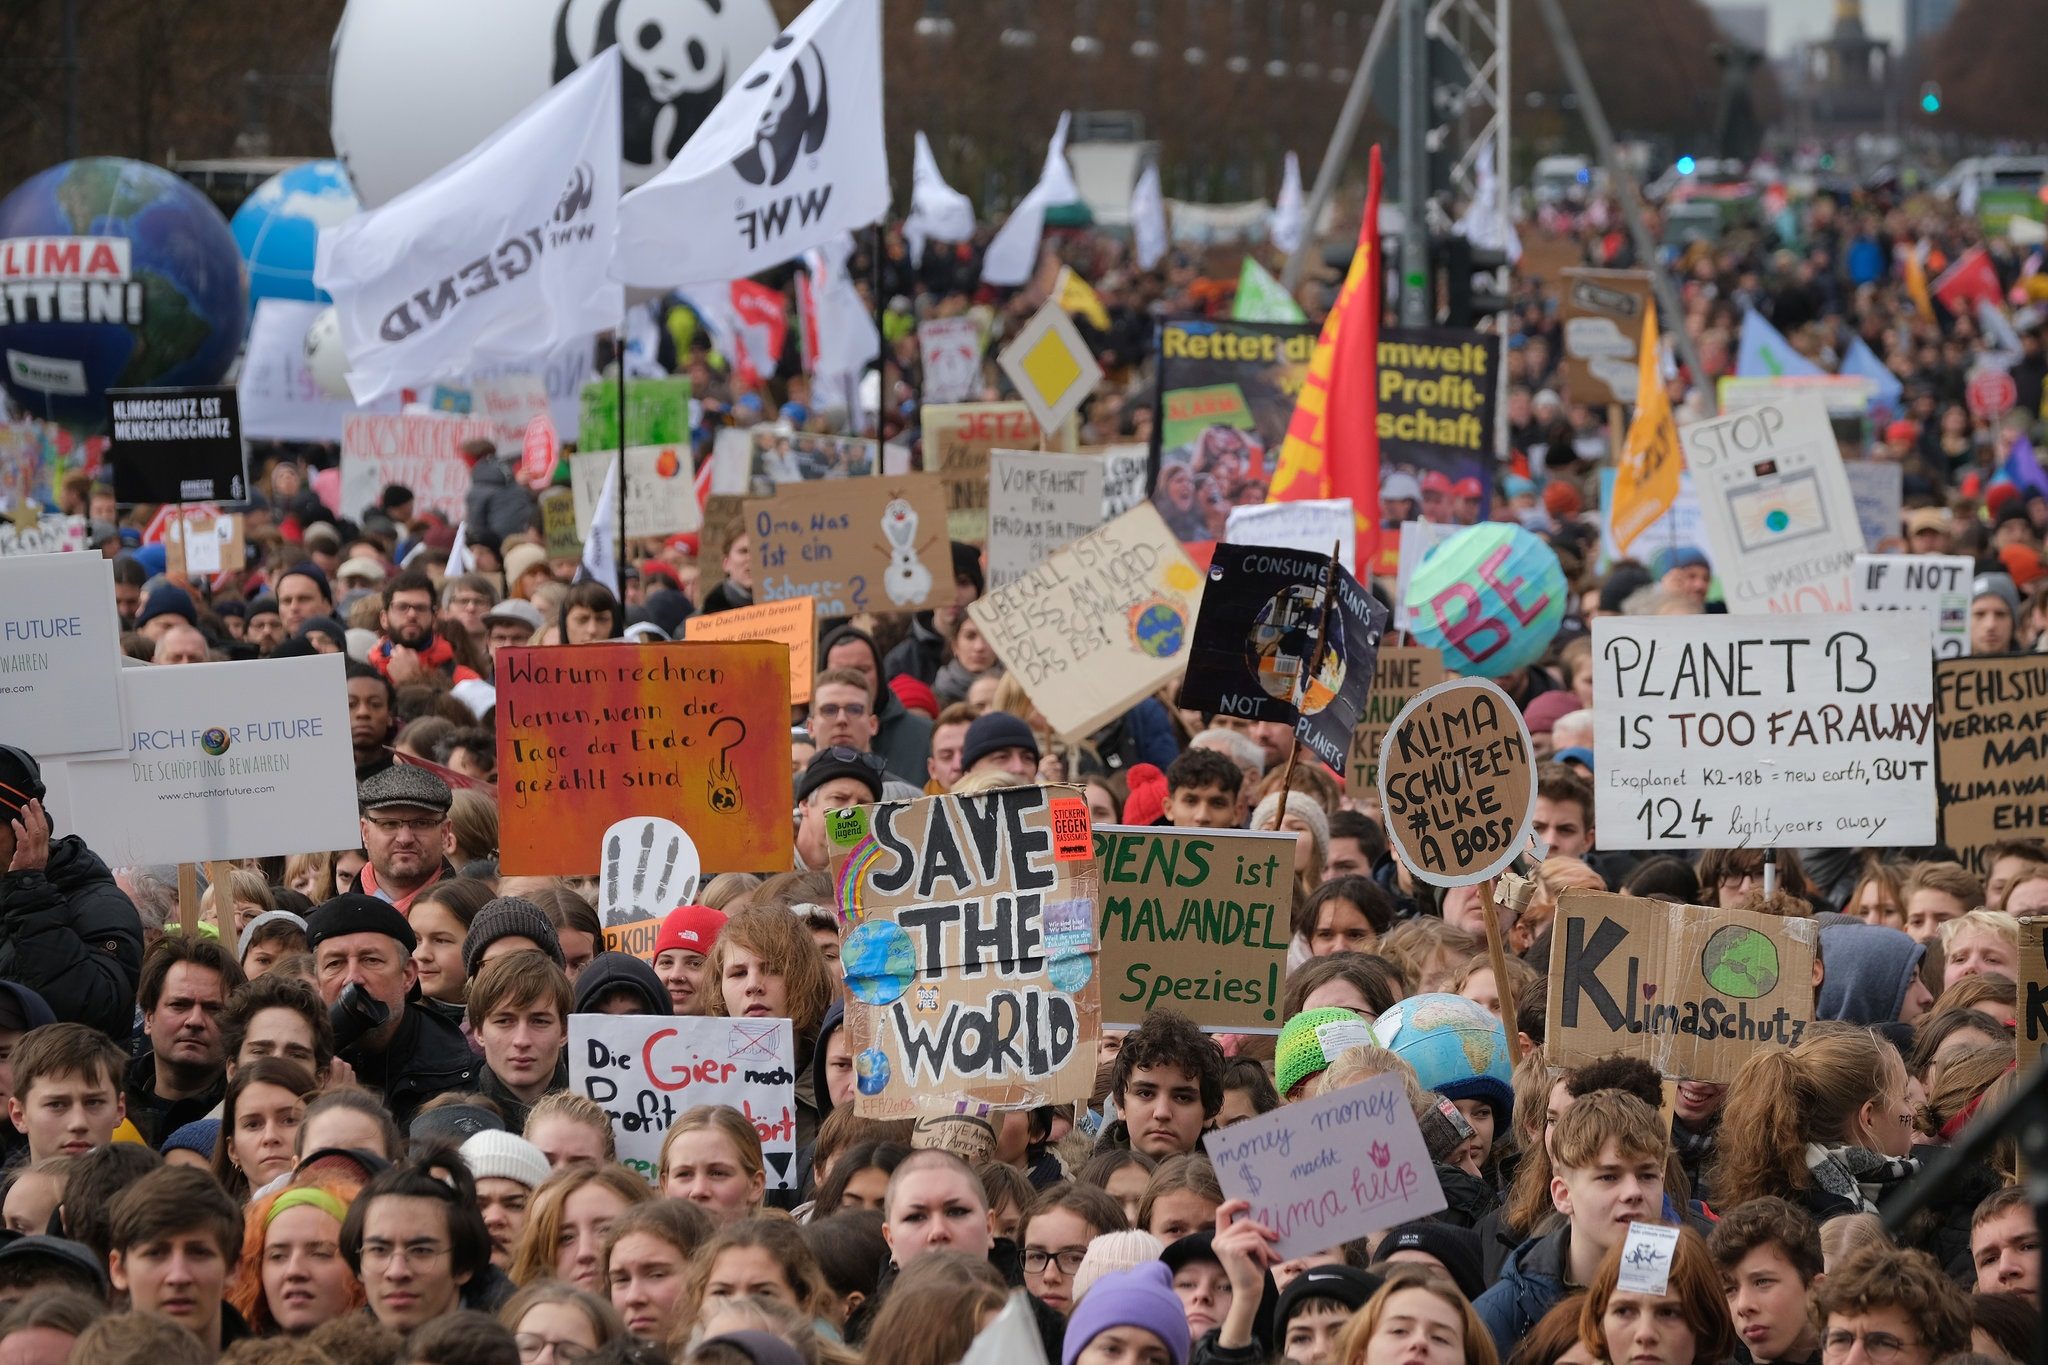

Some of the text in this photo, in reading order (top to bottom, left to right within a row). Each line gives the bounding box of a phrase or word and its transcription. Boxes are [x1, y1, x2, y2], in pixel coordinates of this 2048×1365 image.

[1163, 328, 1276, 361] Rettet
[1380, 371, 1485, 407] Profit-
[113, 397, 222, 420] KLIMASCHUTZ IST
[115, 418, 231, 440] MENSCHENSCHUTZ
[1376, 411, 1481, 449] schaft
[1690, 406, 1784, 467] STOP
[1000, 465, 1088, 495] VORFAHRT
[1242, 555, 1329, 583] CONSUME
[1866, 564, 1963, 591] IF NOT
[1067, 576, 1101, 606] AM
[1339, 580, 1372, 627] PLANTS
[5, 616, 82, 641] FUTURE
[715, 609, 766, 627] Dachstuhl
[768, 602, 802, 616] brennt
[1006, 635, 1050, 668] POL
[1024, 626, 1112, 686] DAS EIS!
[1604, 631, 1876, 700] PLANET B
[508, 653, 724, 685] Warum rechnen
[683, 696, 724, 716] die
[1220, 693, 1268, 714] NOT
[247, 717, 323, 742] FUTURE
[1296, 717, 1344, 772] PLANETS
[1620, 714, 1652, 749] IS
[1668, 711, 1755, 747] TOO
[507, 737, 570, 773] Tage
[587, 736, 622, 755] der
[631, 729, 697, 751] Erde
[515, 760, 683, 809] gezählt sind
[1386, 730, 1526, 815] SCHÜTZEN
[1611, 769, 1687, 795] Exoplanet
[1703, 767, 1762, 786] K2-18b
[1785, 770, 1816, 783] new
[1823, 761, 1870, 785] earth,
[1873, 758, 1928, 781] BUT
[158, 784, 275, 800] www.churchforfuture.com
[837, 820, 859, 830] BUND
[1054, 809, 1086, 820] STICKERN
[1055, 819, 1088, 834] GEGEN
[1637, 797, 1713, 840] 124
[1836, 817, 1887, 838] away
[835, 825, 862, 840] jugend
[872, 787, 1055, 897] SAVE
[1057, 833, 1088, 842] RASSISMUS
[1420, 817, 1513, 872] A BOSS
[1235, 854, 1280, 888] ist
[896, 893, 1051, 980] THE
[1065, 974, 1090, 992] FUTURE
[1120, 962, 1279, 1021] Spezies!
[918, 1000, 936, 1009] FREE
[892, 989, 1077, 1081] WORLD
[587, 1038, 631, 1070] Die
[642, 1028, 737, 1092] Gier
[744, 1066, 793, 1086] nach
[941, 1123, 971, 1138] SAVE
[1217, 1128, 1295, 1166] money
[1311, 1090, 1399, 1131] money
[1290, 1149, 1342, 1180] macht
